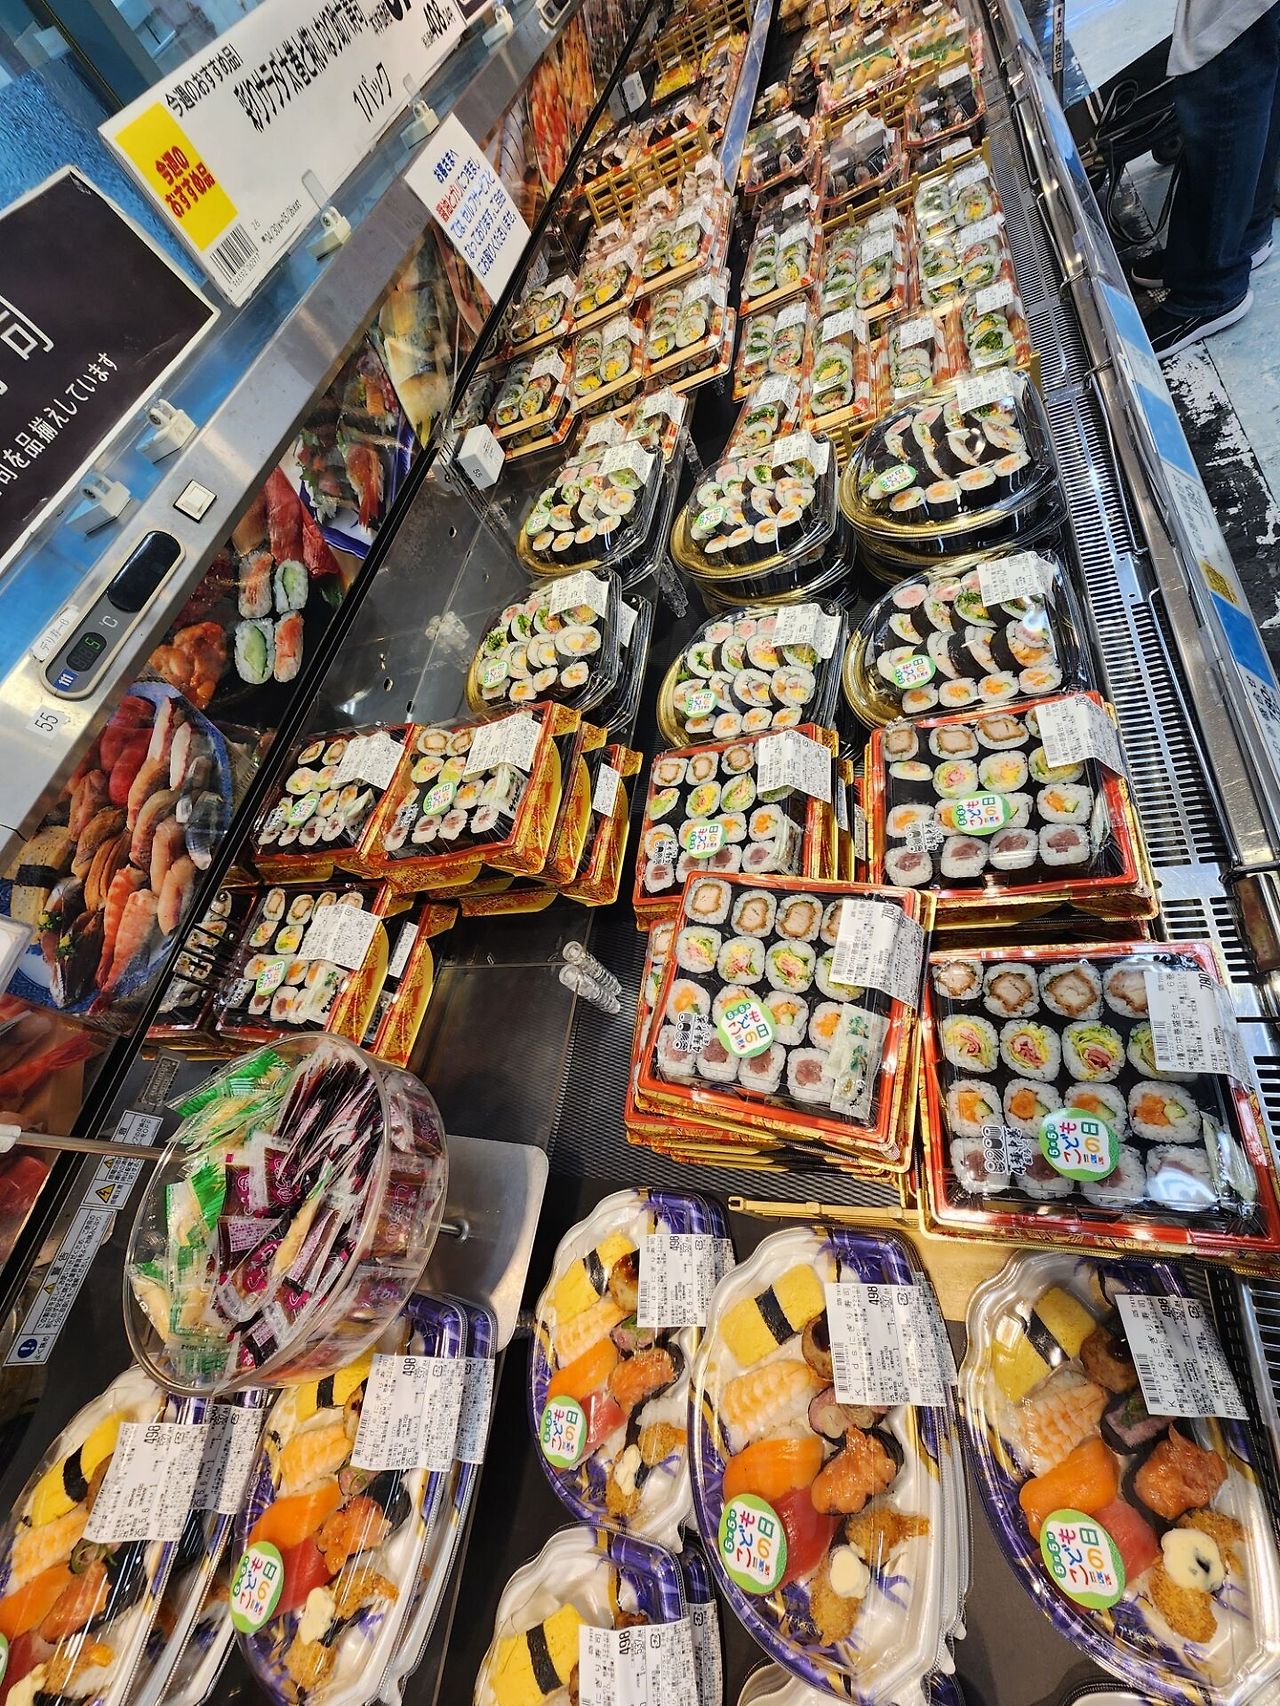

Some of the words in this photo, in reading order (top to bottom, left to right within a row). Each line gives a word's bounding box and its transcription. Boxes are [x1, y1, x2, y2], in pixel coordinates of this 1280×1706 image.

[167, 42, 244, 118] 今週のおすすめ品!
[352, 61, 393, 123] 1パック
[153, 144, 189, 183] 今週の
[430, 147, 460, 184] お客さまへ
[165, 160, 217, 219] おすすめ品
[0, 348, 120, 495] 司を品揃えしています
[34, 712, 59, 733] 55
[1198, 973, 1213, 990] 780
[728, 1010, 761, 1037] こども
[745, 1023, 770, 1044] の日
[1059, 1122, 1083, 1166] こども
[1080, 1122, 1101, 1155] の日
[669, 1235, 679, 1250] 498
[867, 1285, 879, 1304] 498
[1157, 1298, 1172, 1316] 498
[401, 1356, 416, 1377] 498
[143, 1423, 161, 1444] 498
[552, 1407, 566, 1452] こども
[565, 1409, 579, 1442] の日
[736, 1510, 755, 1568] こども
[757, 1516, 775, 1560] の日
[1059, 1527, 1090, 1586] こども
[1079, 1527, 1105, 1571] の日
[240, 1556, 263, 1610] こども
[257, 1561, 277, 1601] の日
[618, 1630, 630, 1654] 498
